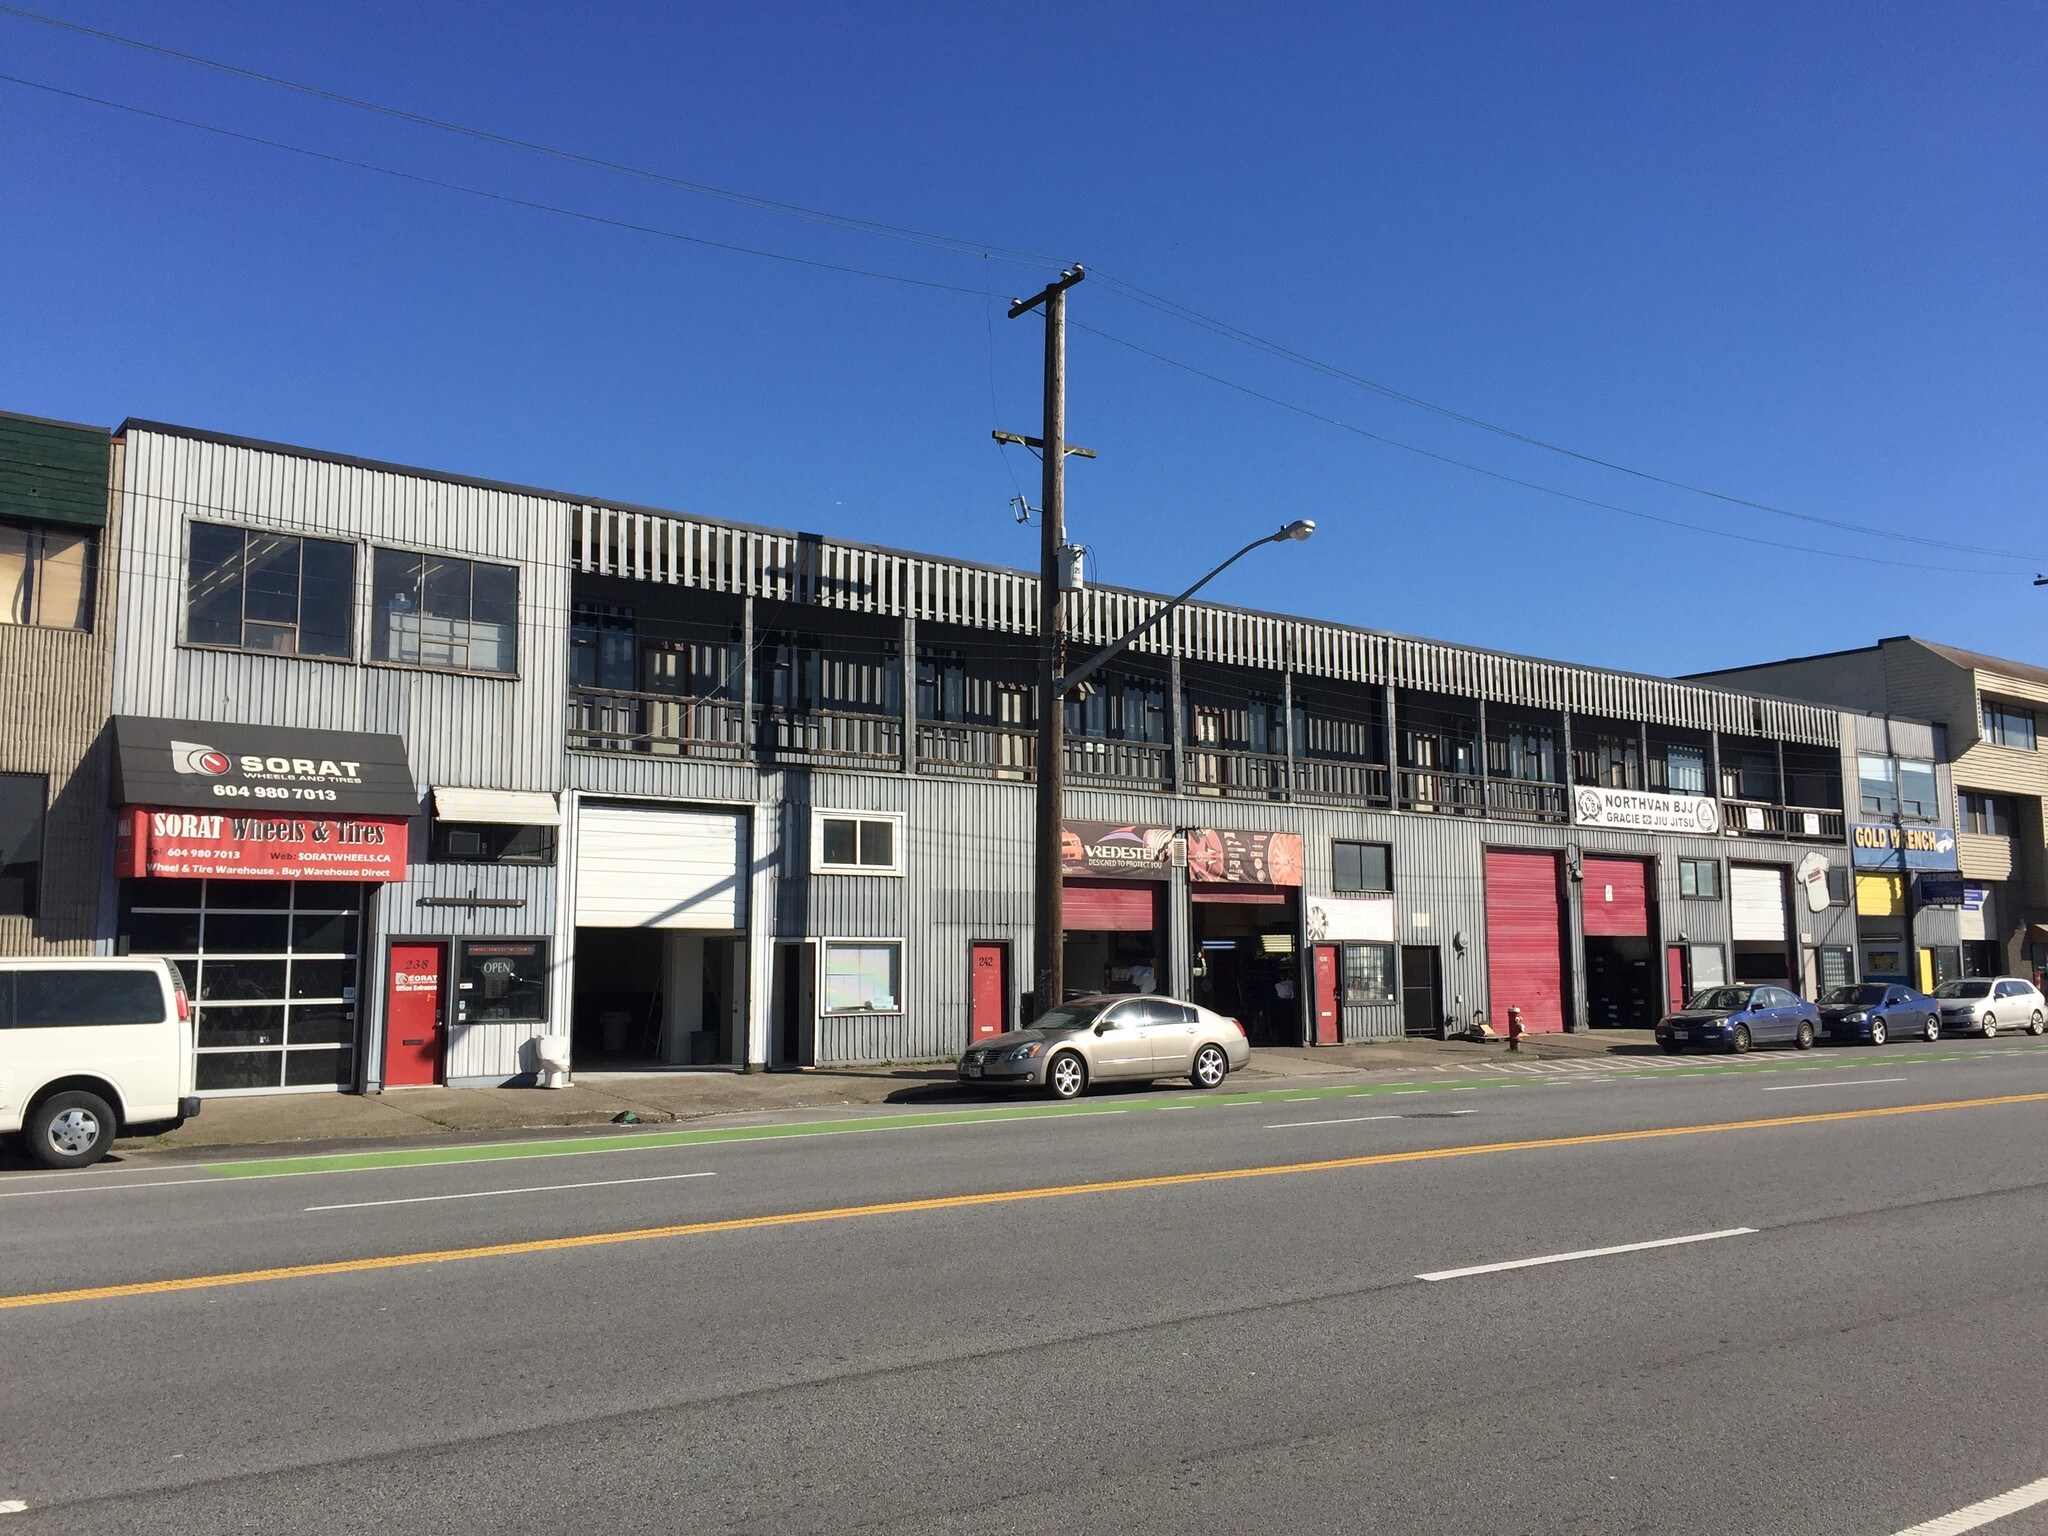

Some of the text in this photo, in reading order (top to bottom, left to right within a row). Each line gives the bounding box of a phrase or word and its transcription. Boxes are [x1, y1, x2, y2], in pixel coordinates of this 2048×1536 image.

[240, 756, 361, 777] SORAT
[243, 772, 362, 784] WHEELS AND TIRES
[212, 784, 337, 801] 604 980 7013
[1605, 795, 1693, 814] NORTHVAN BJJ
[1606, 812, 1695, 828] GRACIE JIU JITSU
[154, 813, 224, 839] SORAT
[230, 818, 306, 843] Wheels
[311, 820, 330, 843] &
[337, 821, 385, 845] Tires
[1854, 826, 1937, 851] GOLD WRENCH
[167, 848, 188, 857] 604
[190, 849, 211, 858] 980
[213, 850, 241, 859] 7013
[270, 852, 297, 860] Web:
[297, 852, 391, 862] SORATWHEELS.CA
[147, 862, 390, 877] Wheel & Tire Warehouse Buy Warehouse Direct
[1088, 858, 1117, 867] DESIGNED
[1126, 860, 1149, 868] PROTECT
[405, 959, 429, 970] 238
[483, 961, 511, 974] OPEN
[979, 956, 993, 967] 242
